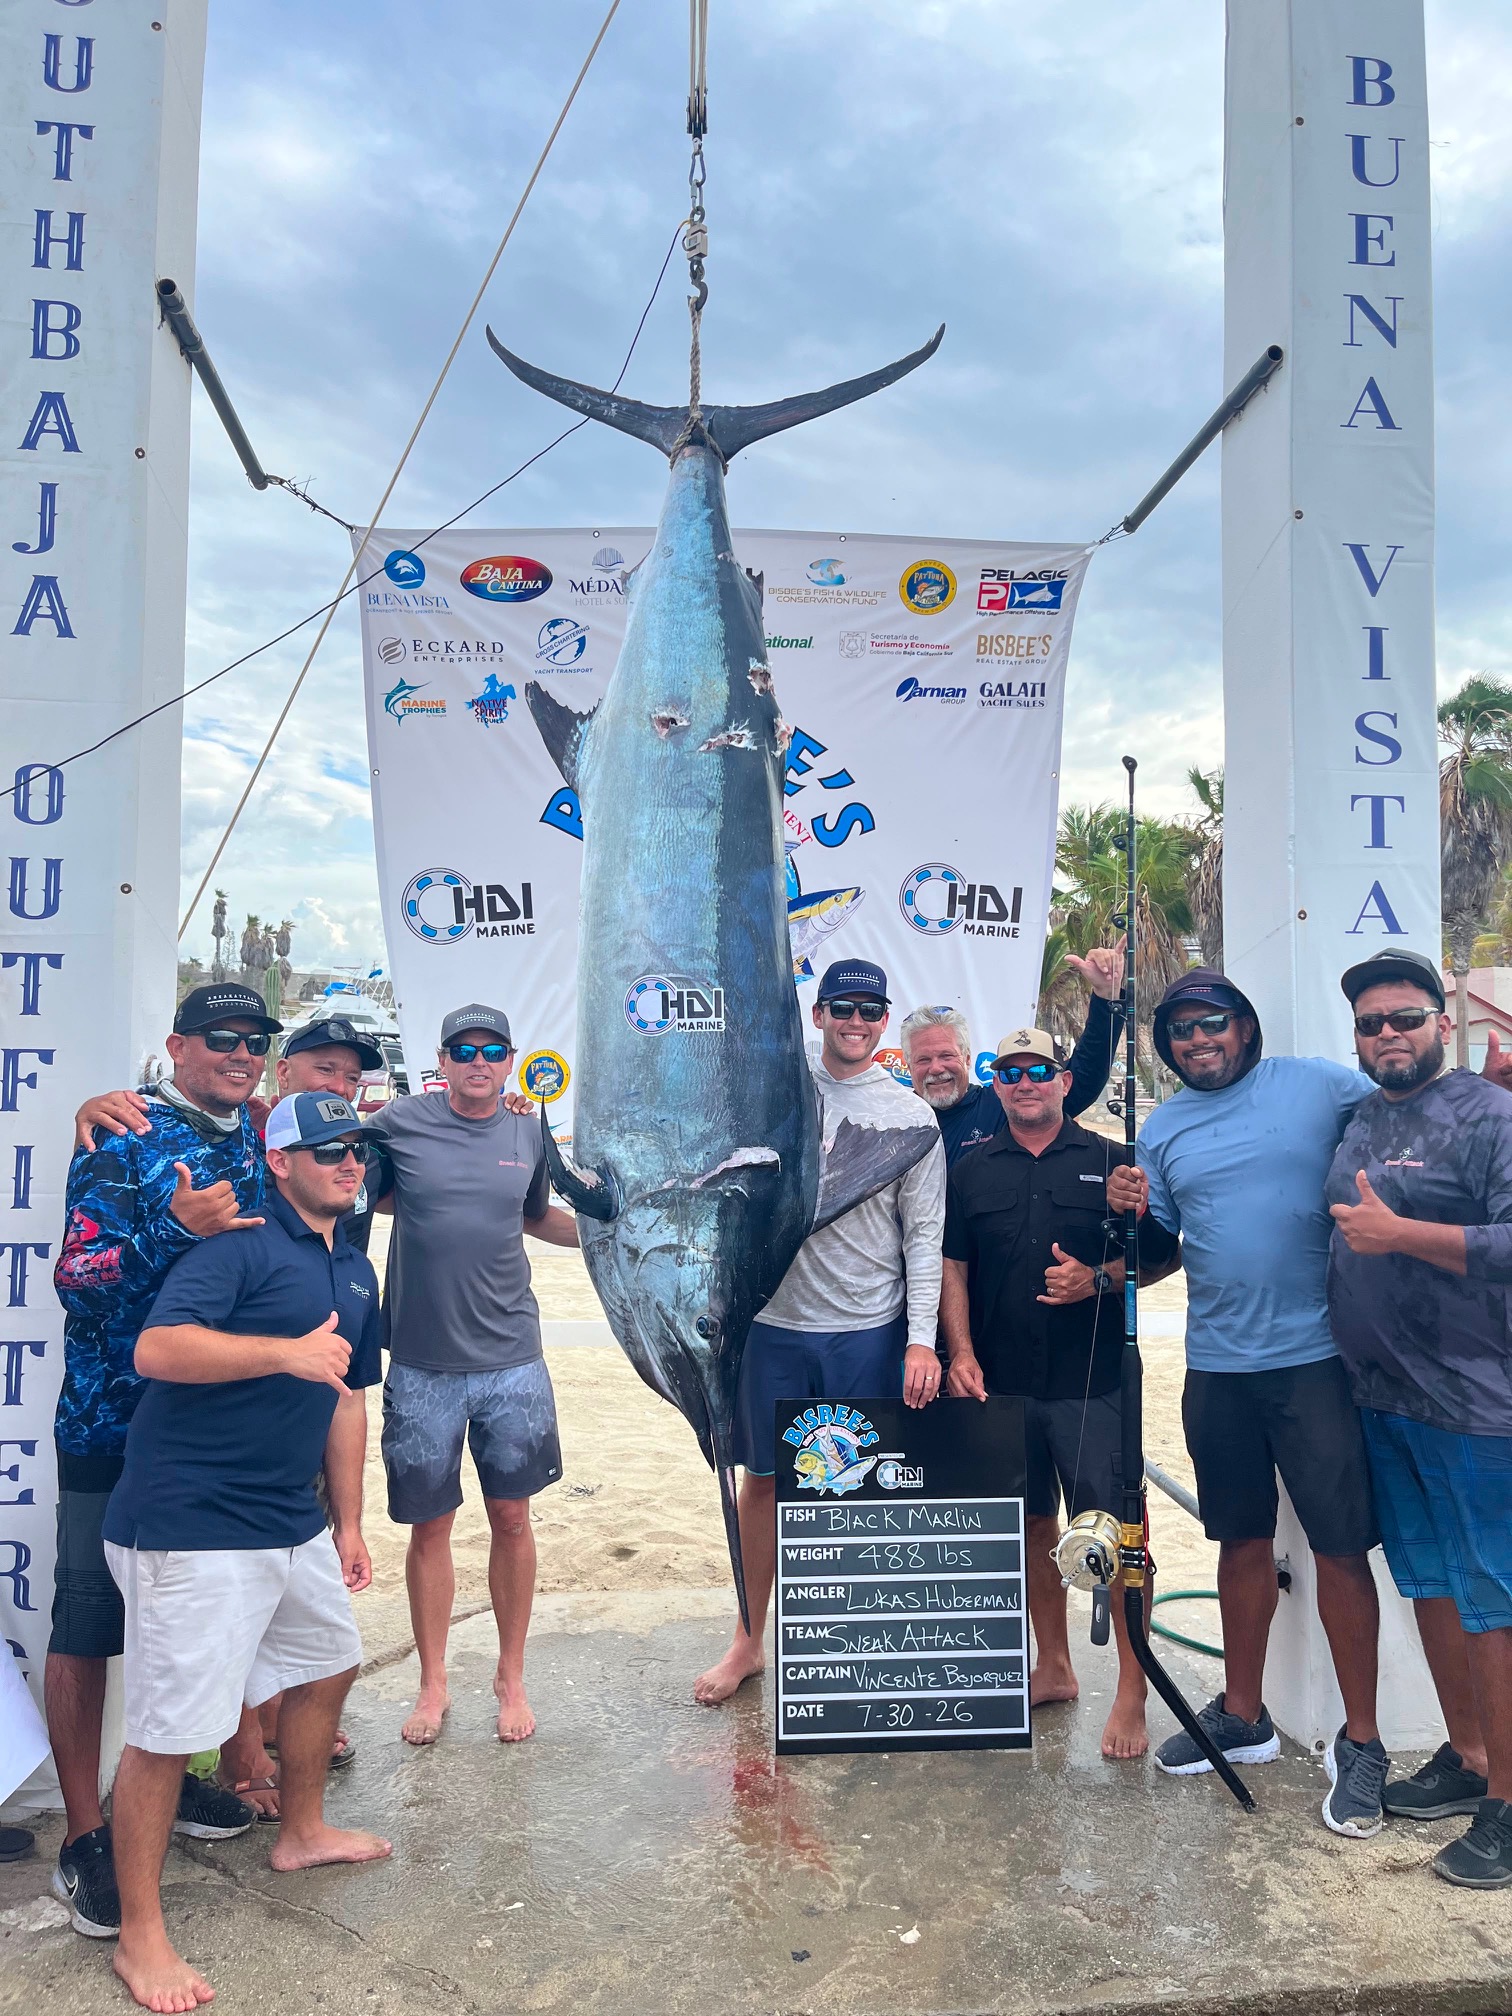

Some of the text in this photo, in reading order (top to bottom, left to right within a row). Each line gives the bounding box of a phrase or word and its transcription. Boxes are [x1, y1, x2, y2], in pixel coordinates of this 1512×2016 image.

[1340, 55, 1405, 431] BUENA
[10, 0, 97, 638] UTHBAJA
[470, 564, 523, 584] BAJA
[980, 569, 1070, 581] PELAGIC
[487, 579, 543, 595] CANTINA
[568, 577, 625, 595] MÉDA
[768, 588, 887, 598] BISBEE'S FISH & WILDLIFE
[368, 593, 450, 608] BUENA VISTA
[575, 598, 604, 606] HOTEL
[776, 596, 878, 606] CONSERVATION FUND
[412, 639, 504, 654] ECKARD
[535, 625, 591, 659] CROSS CHARTERING
[910, 641, 950, 650] Economía
[977, 634, 1052, 658] BISBEE'S
[414, 656, 503, 664] ENTERPRISES
[979, 681, 1046, 698] GALATI
[402, 700, 447, 708] MARINE
[471, 698, 508, 708] NATIVE
[981, 699, 1045, 708] YACHT SALES
[474, 707, 504, 718] SPIRIT
[1342, 543, 1409, 935] VISTA
[453, 882, 534, 925] HDI
[947, 882, 1023, 923] HDI
[476, 923, 536, 938] MARINE
[963, 923, 1020, 938] MARINE
[661, 990, 723, 1019] HDI
[677, 1021, 723, 1031] MARINE
[0, 763, 67, 1683] OUTFITTER
[783, 1404, 879, 1447] BISBEE'S
[894, 1468, 922, 1482] HDI
[785, 1509, 816, 1522] FISH
[785, 1547, 844, 1561] WEIGHT
[858, 1543, 972, 1569] 488 lbs
[785, 1586, 846, 1600] ANGLER
[785, 1626, 829, 1639] TEAM
[786, 1666, 851, 1680] CAPTAIN
[786, 1704, 825, 1718] DATE
